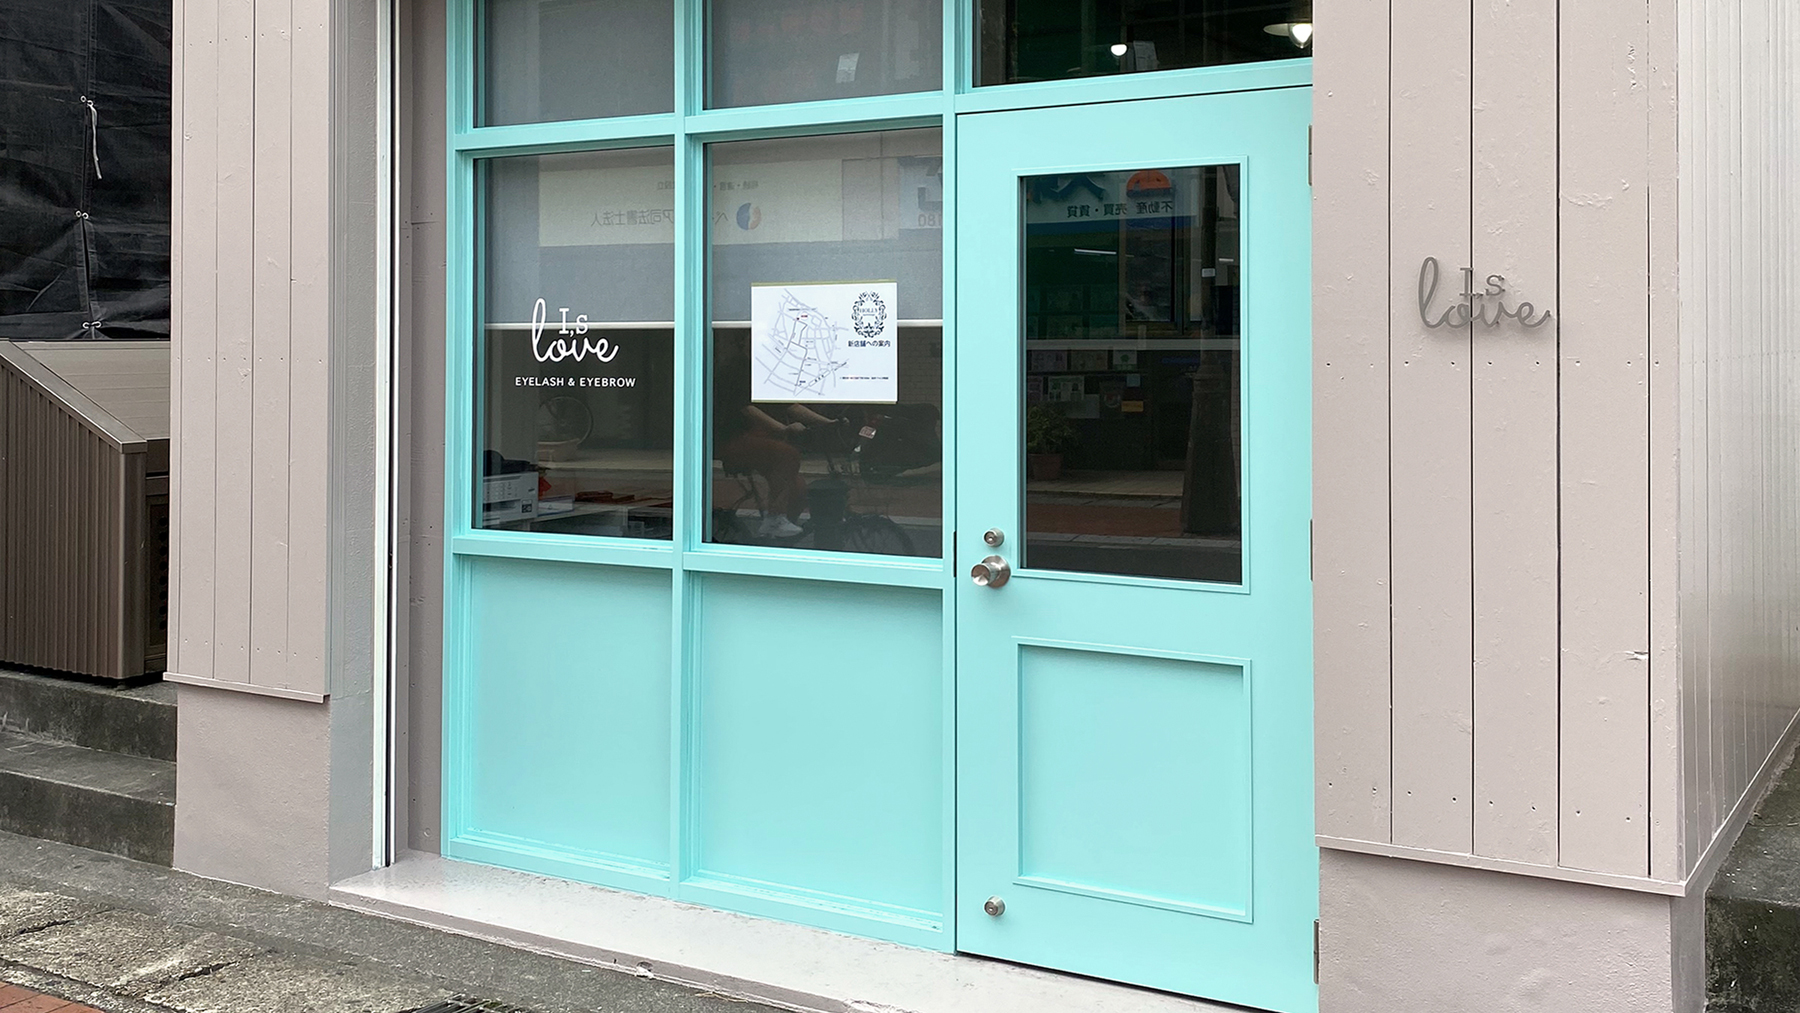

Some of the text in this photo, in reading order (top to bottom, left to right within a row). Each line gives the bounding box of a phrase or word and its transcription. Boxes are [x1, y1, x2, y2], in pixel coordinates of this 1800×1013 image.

[1418, 256, 1551, 328] love
[531, 297, 619, 363] love
[515, 376, 636, 387] EYELASH & EYEBROW
